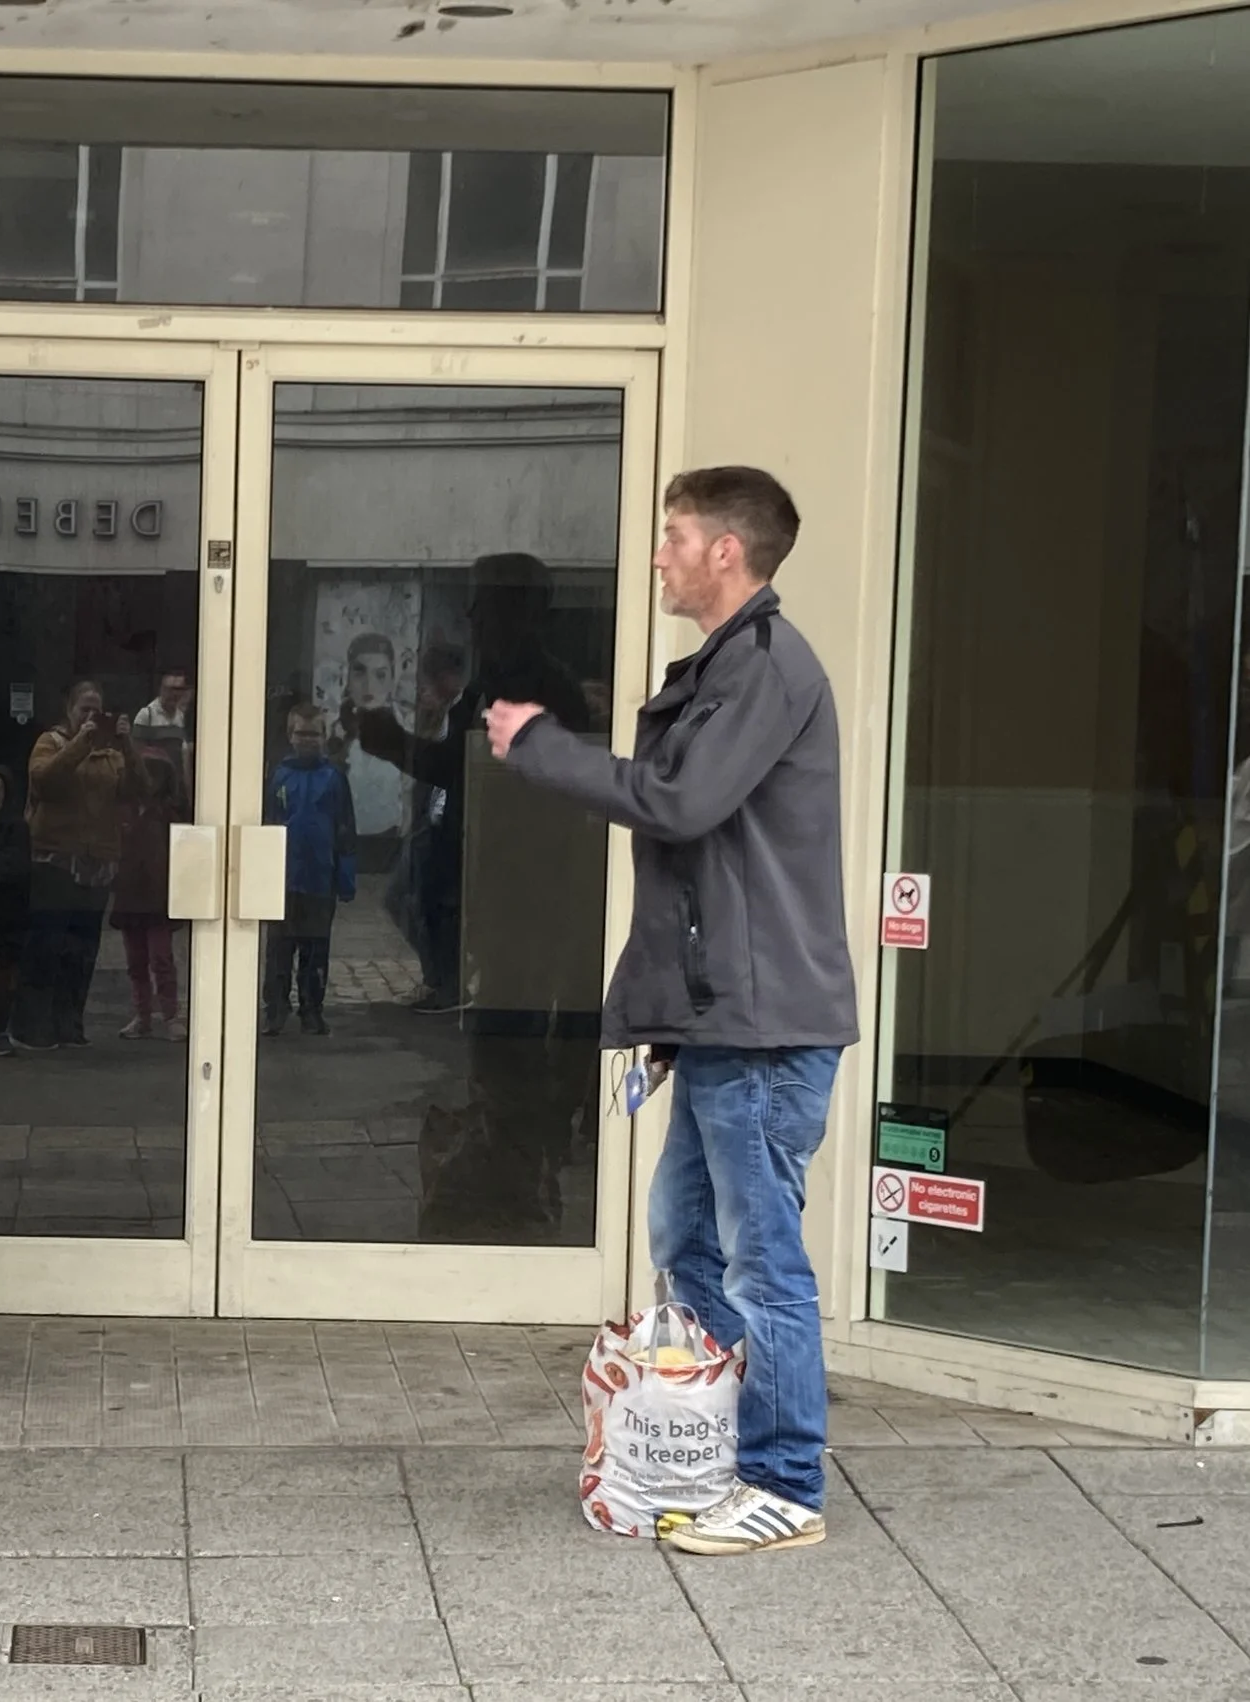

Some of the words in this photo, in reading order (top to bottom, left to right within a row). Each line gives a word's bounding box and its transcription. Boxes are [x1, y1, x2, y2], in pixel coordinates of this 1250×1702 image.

[888, 920, 899, 931] No
[901, 922, 922, 934] dogs
[910, 1181, 925, 1194] No
[927, 1185, 977, 1201] electronic
[918, 1200, 968, 1217] cigarettes
[623, 1407, 661, 1438] This
[669, 1420, 709, 1440] bag
[713, 1414, 729, 1434] is
[628, 1444, 639, 1457] a
[645, 1442, 723, 1467] keeper
